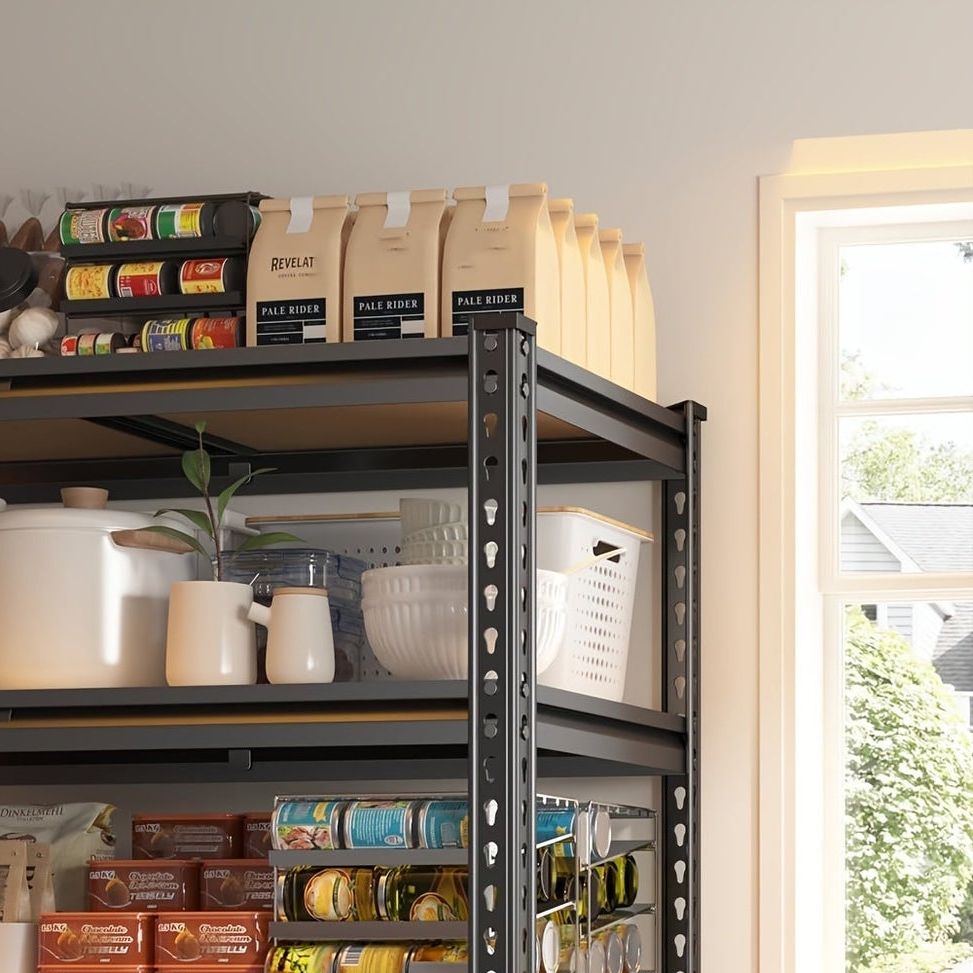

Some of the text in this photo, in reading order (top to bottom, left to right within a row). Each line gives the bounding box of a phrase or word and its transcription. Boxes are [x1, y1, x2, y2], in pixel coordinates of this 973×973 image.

[359, 299, 418, 311] PALE RIDER
[458, 294, 518, 306] PALE RIDER
[262, 304, 320, 316] PALE RIDER
